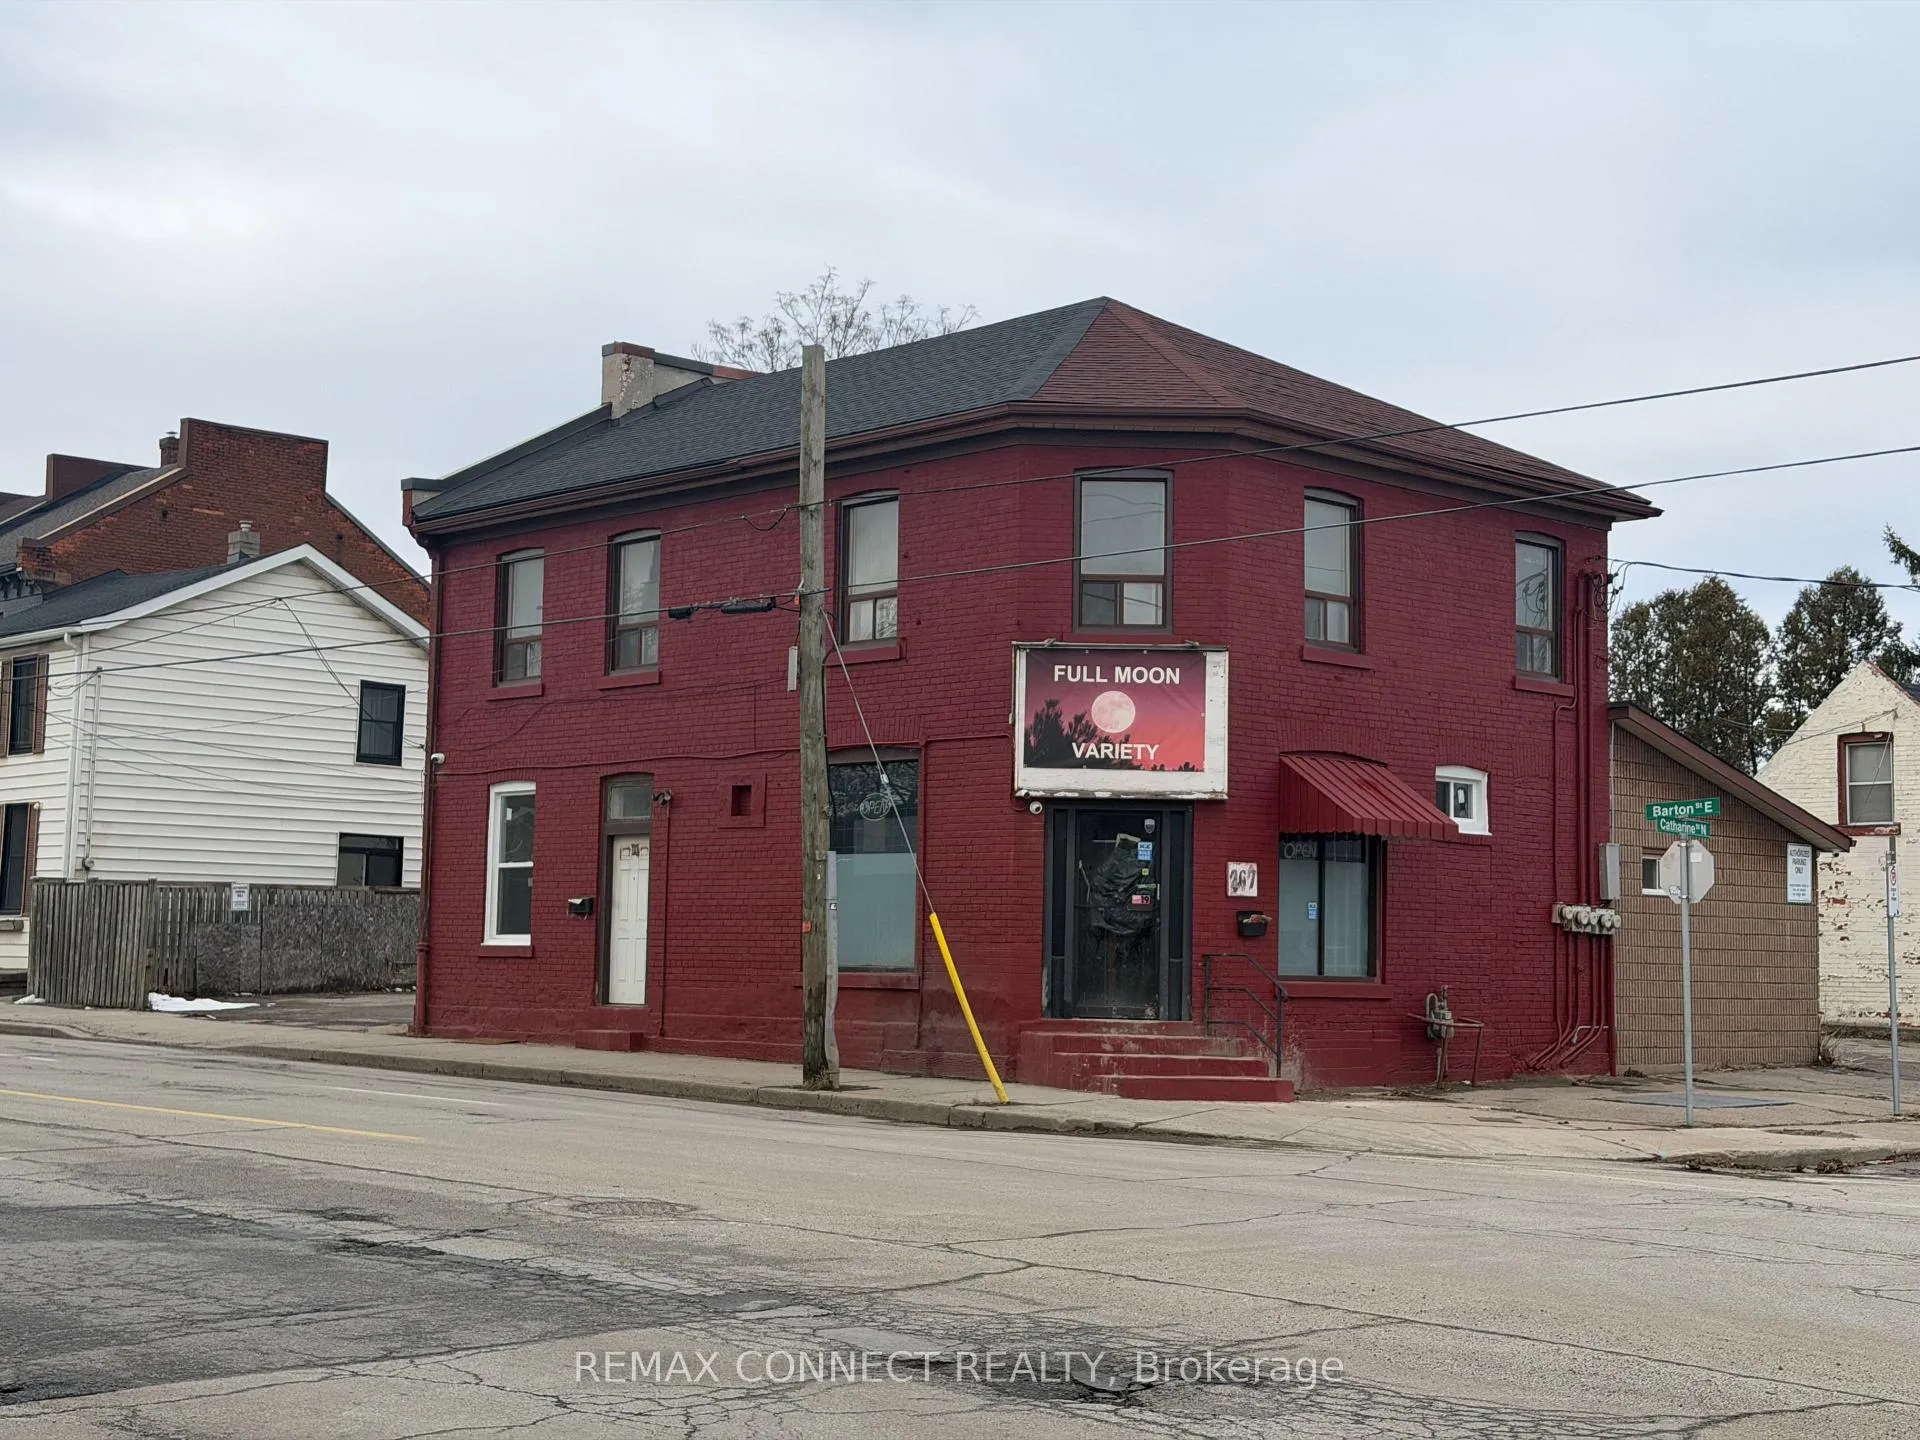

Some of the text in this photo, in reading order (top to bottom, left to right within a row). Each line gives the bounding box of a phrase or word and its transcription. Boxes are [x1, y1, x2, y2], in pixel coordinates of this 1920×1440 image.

[1053, 664, 1180, 685] FULL MOON
[1071, 742, 1159, 761] VARIETY
[1652, 804, 1694, 817] Barton
[1704, 801, 1713, 813] E
[1660, 818, 1696, 834] Catharine
[1700, 823, 1707, 835] N
[1284, 841, 1318, 858] OPEN
